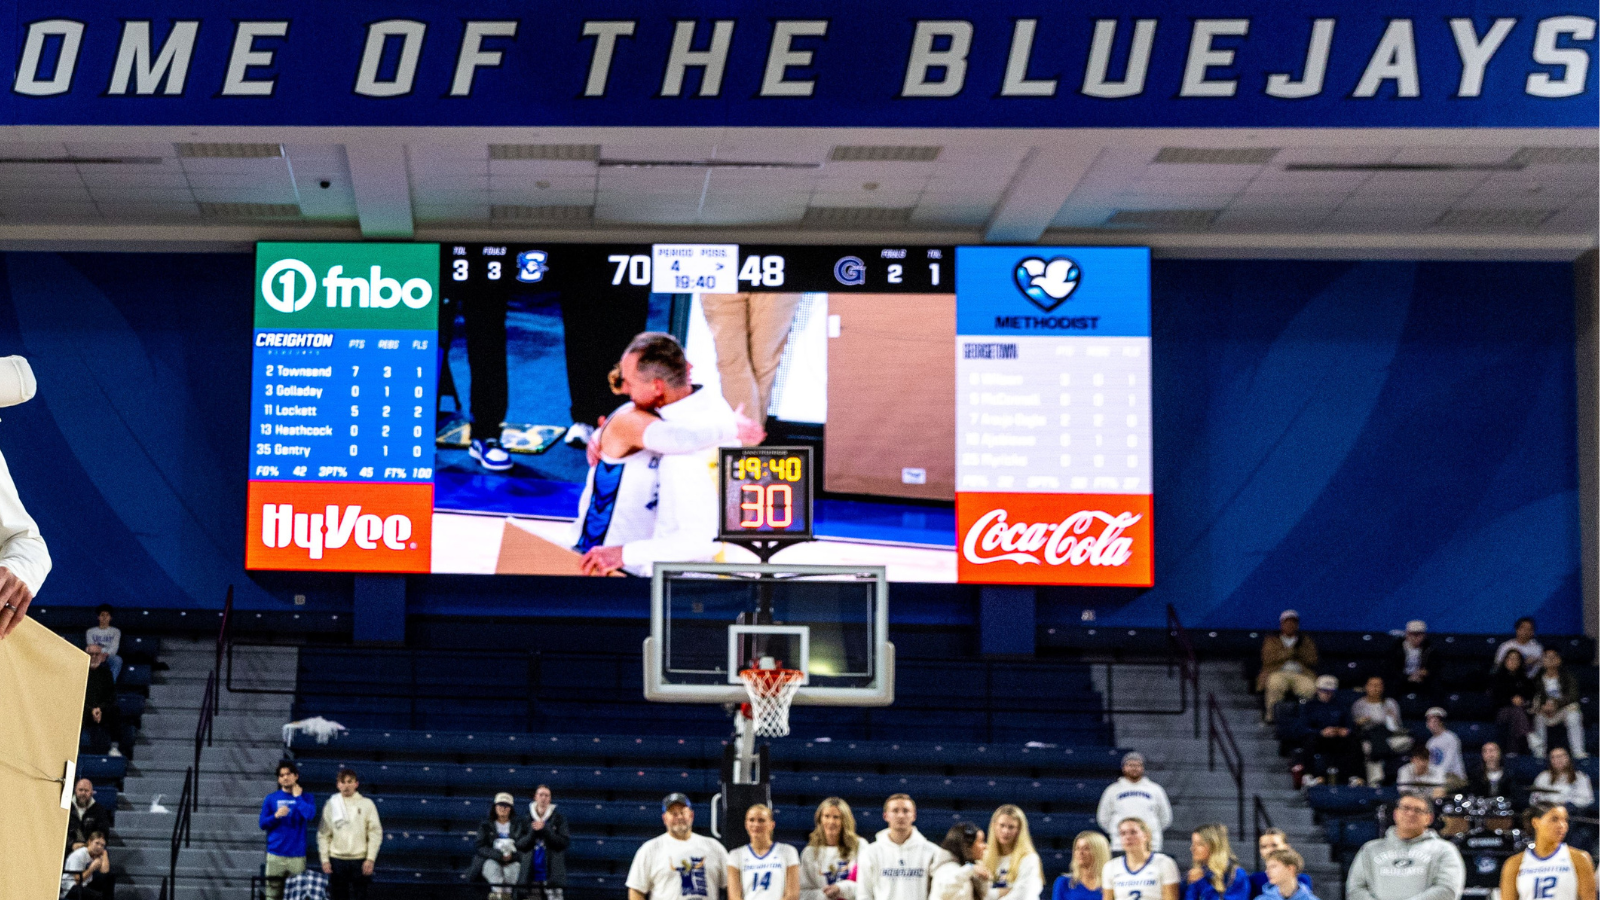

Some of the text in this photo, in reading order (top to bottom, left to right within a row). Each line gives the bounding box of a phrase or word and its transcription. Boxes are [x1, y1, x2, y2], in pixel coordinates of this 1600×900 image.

[354, 19, 518, 96] OF
[583, 20, 828, 96] THE
[901, 16, 1597, 98] BLUEJAYS
[658, 249, 693, 257] PERIOD
[453, 259, 501, 281] 3 3
[608, 255, 651, 285] 70
[671, 260, 680, 271] 4
[738, 255, 785, 286] 48
[675, 275, 716, 289] 19:40
[887, 263, 940, 286] 2 1
[322, 265, 433, 309] fnbo
[994, 316, 1100, 330] METHODIST
[255, 333, 333, 348] CREIGHTON
[349, 339, 366, 349] PTS
[266, 365, 422, 378] 2 Townsend 7 3 1
[265, 384, 423, 399] 3 Golladay 0 1 0
[264, 404, 422, 418] 11 Lockett 5 2 2
[260, 424, 422, 438] 13 Heathcock 0 2 0
[256, 443, 422, 458] 35 Gentry 0 1 0
[256, 466, 432, 478] FG% 42 3PT% 45 FT% 100
[739, 457, 801, 481] 19:40
[740, 484, 792, 527] 30
[752, 871, 772, 891] 14
[1534, 876, 1557, 899] 12
